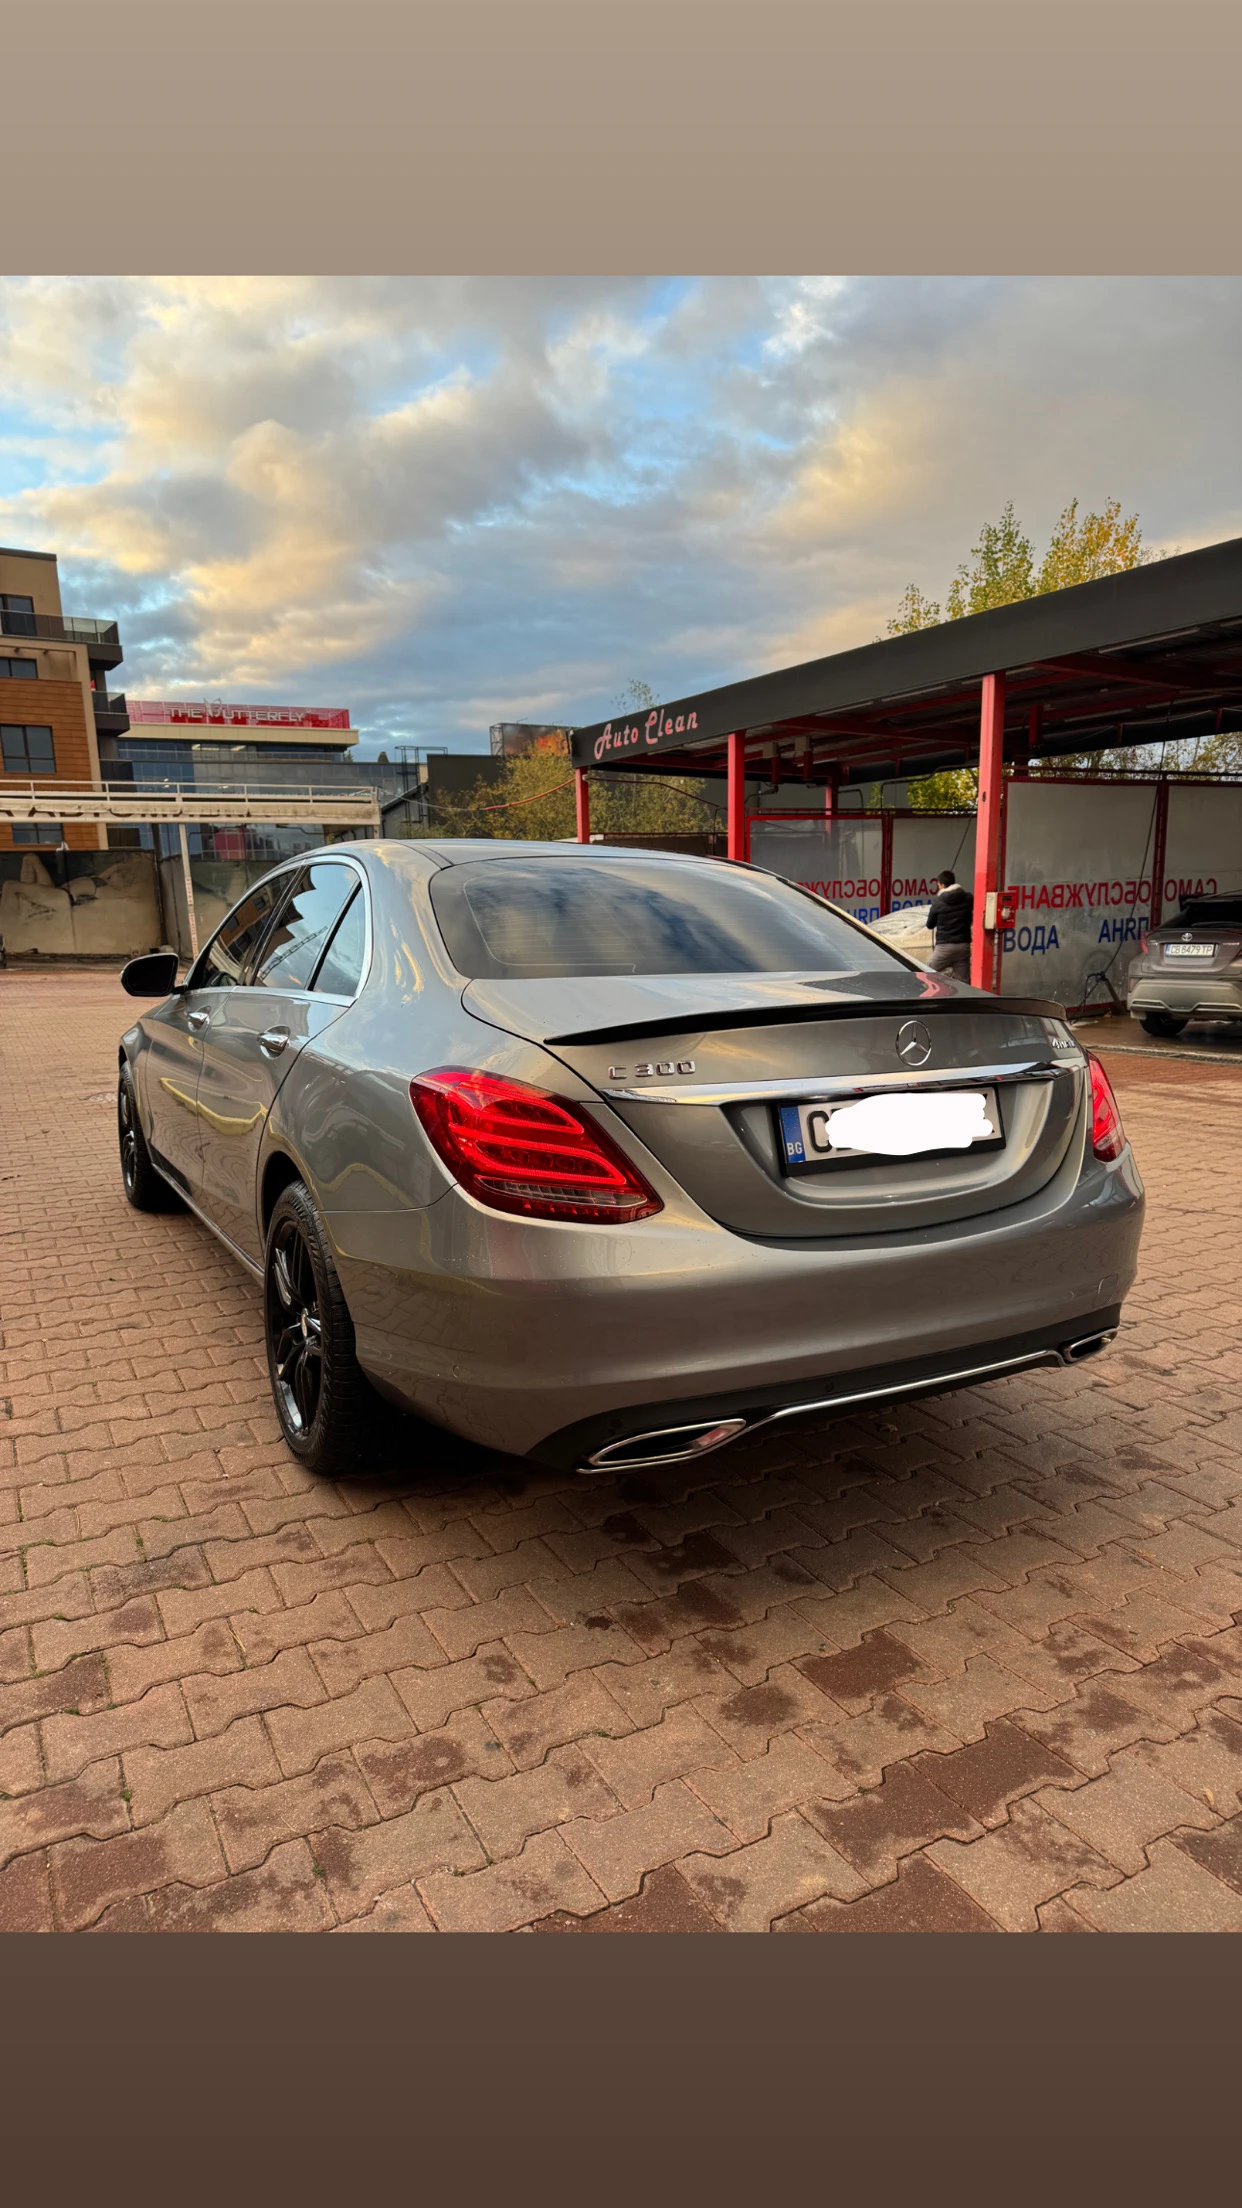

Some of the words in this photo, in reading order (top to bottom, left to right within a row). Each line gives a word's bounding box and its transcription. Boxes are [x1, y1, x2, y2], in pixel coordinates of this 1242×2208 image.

[167, 707, 204, 719] THE
[593, 723, 639, 760] Auto
[645, 708, 699, 745] Clean
[1003, 925, 1060, 955] ВОДА
[1202, 945, 1213, 954] TP
[608, 1064, 628, 1080] C
[634, 1060, 696, 1078] 300
[787, 1141, 803, 1157] BG
